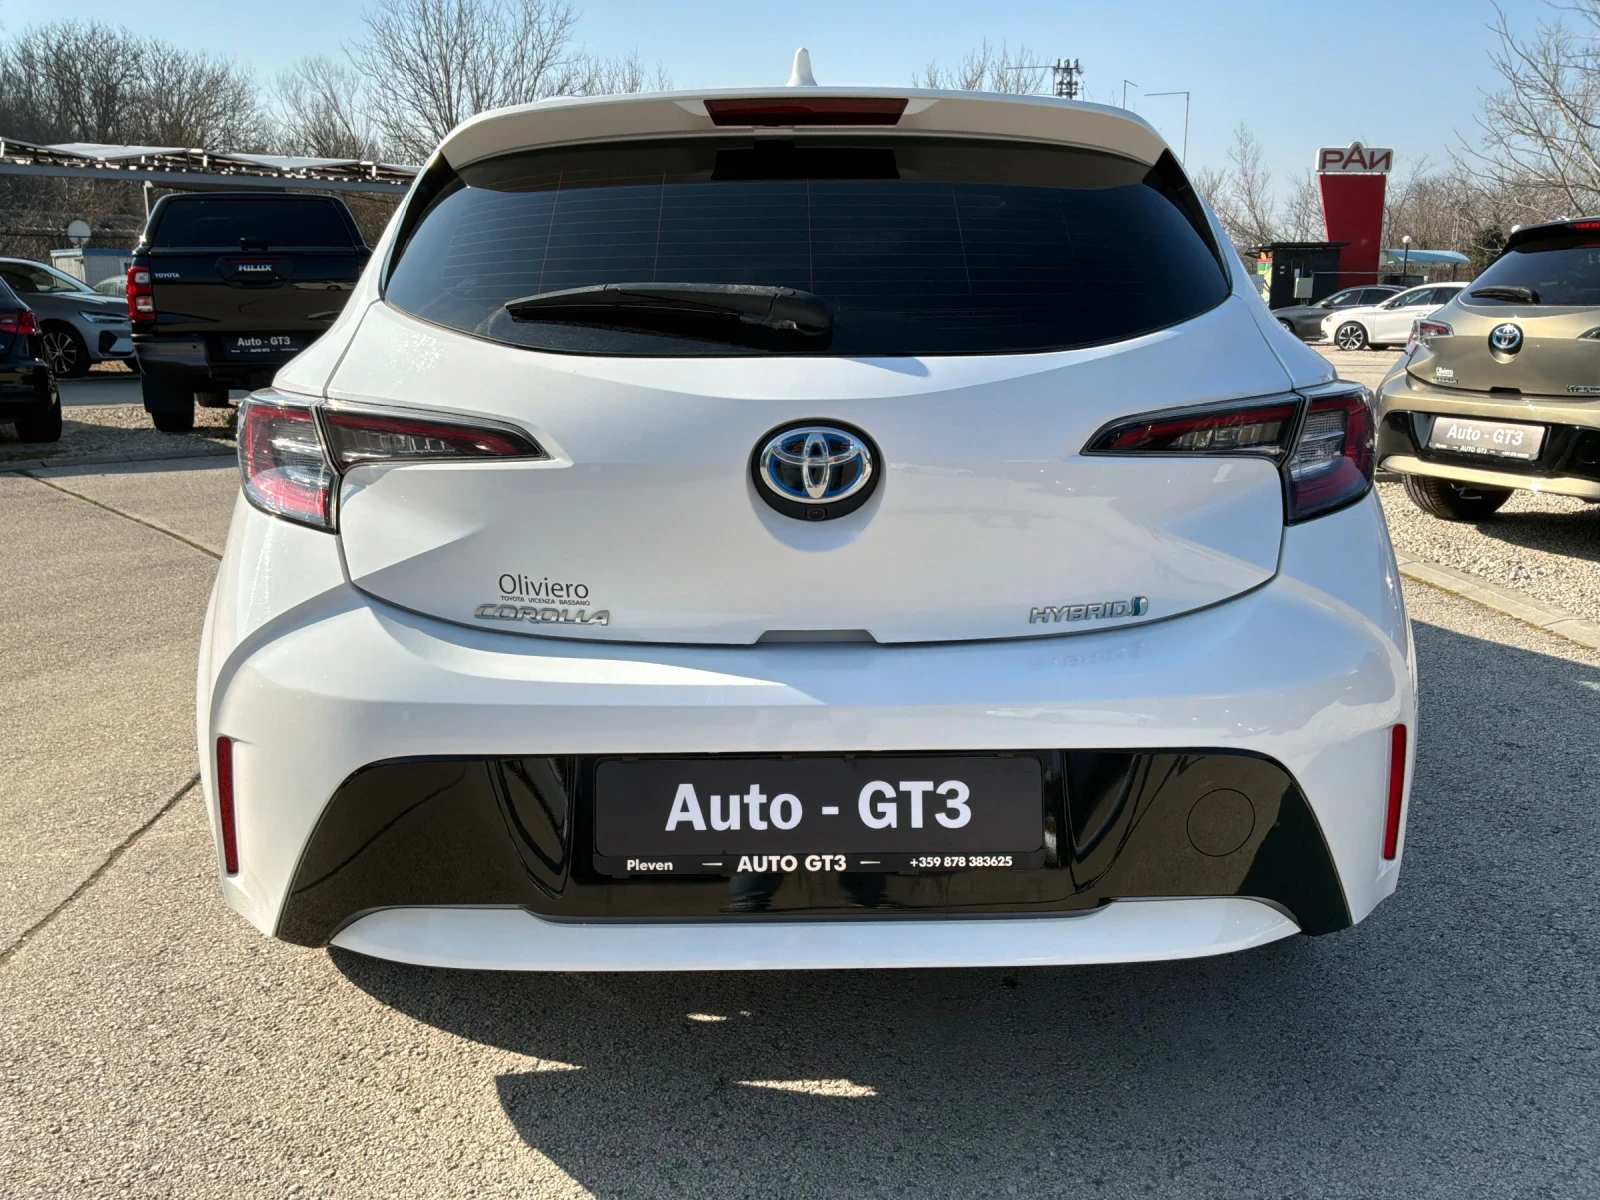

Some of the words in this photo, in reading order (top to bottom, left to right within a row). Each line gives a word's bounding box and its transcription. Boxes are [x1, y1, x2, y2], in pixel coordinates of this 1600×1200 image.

[238, 264, 272, 272] HILUX
[237, 337, 262, 347] Auto
[270, 336, 291, 346] GT3
[1446, 424, 1481, 441] Auto
[1492, 428, 1524, 446] GT3
[1460, 445, 1476, 453] AUTO
[498, 573, 589, 599] Oliviero
[500, 595, 525, 603] TOYOTA
[528, 597, 556, 605] VICENZA
[558, 599, 590, 607] BASSANO
[474, 603, 610, 626] COROLLA
[1029, 601, 1130, 624] HYBRID
[664, 783, 803, 832] Auto
[858, 780, 972, 829] GT3
[626, 859, 673, 871] Pleven
[736, 855, 798, 873] AUTO
[804, 854, 847, 872] GT3
[909, 857, 942, 868] +359
[943, 856, 966, 867] 878
[968, 856, 1013, 867] 383625
